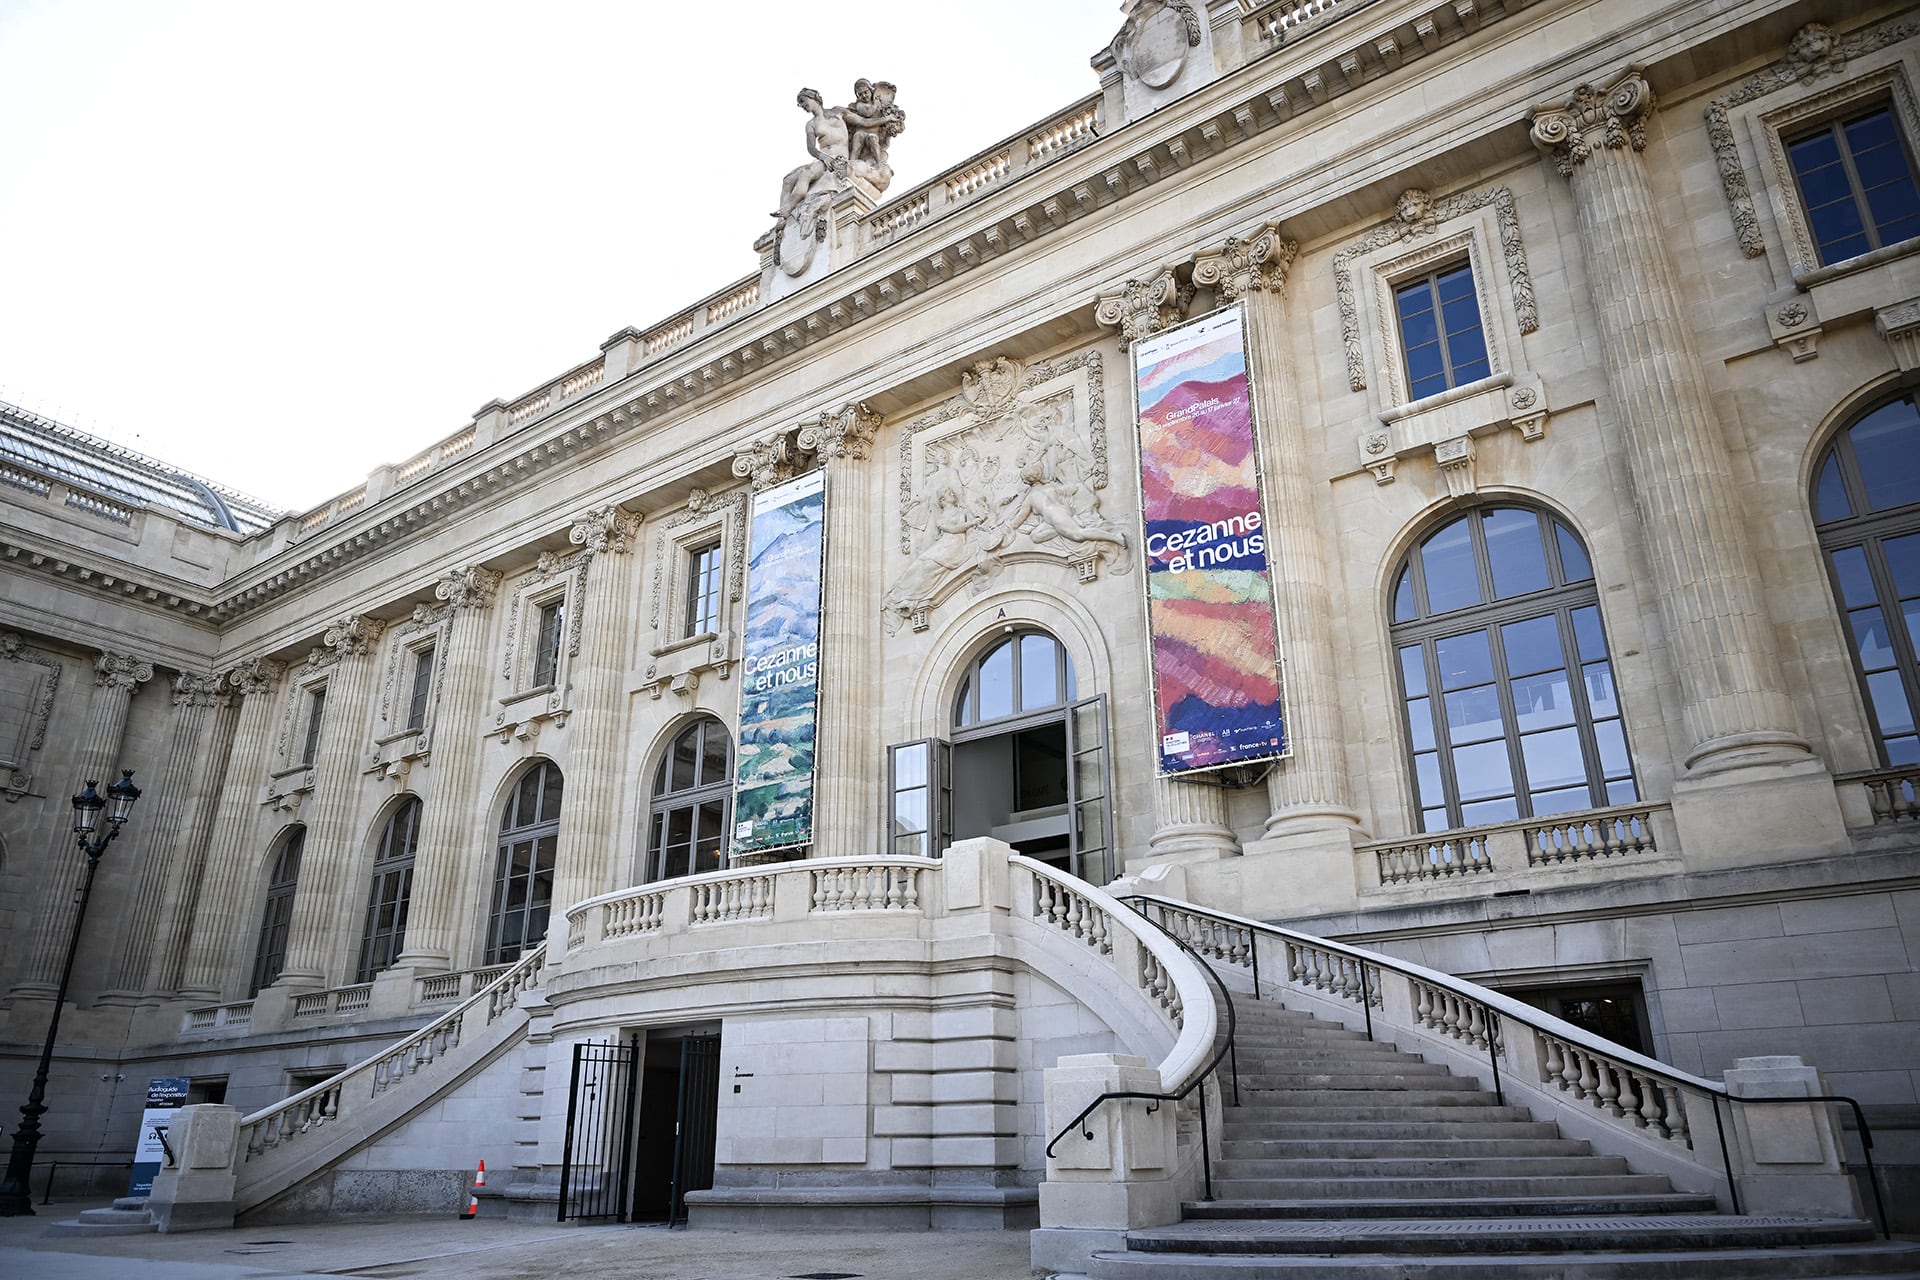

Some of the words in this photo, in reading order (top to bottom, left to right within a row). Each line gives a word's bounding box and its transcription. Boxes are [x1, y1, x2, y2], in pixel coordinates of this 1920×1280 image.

[1166, 397, 1219, 420] GrandPalais
[1147, 511, 1262, 557] Cezanne
[1169, 549, 1195, 574] et
[1199, 534, 1265, 567] nous
[997, 607, 1006, 619] A
[744, 642, 817, 675] Cezanne
[756, 671, 774, 691] et
[775, 662, 817, 688] nous
[1192, 732, 1215, 740] CHANEL
